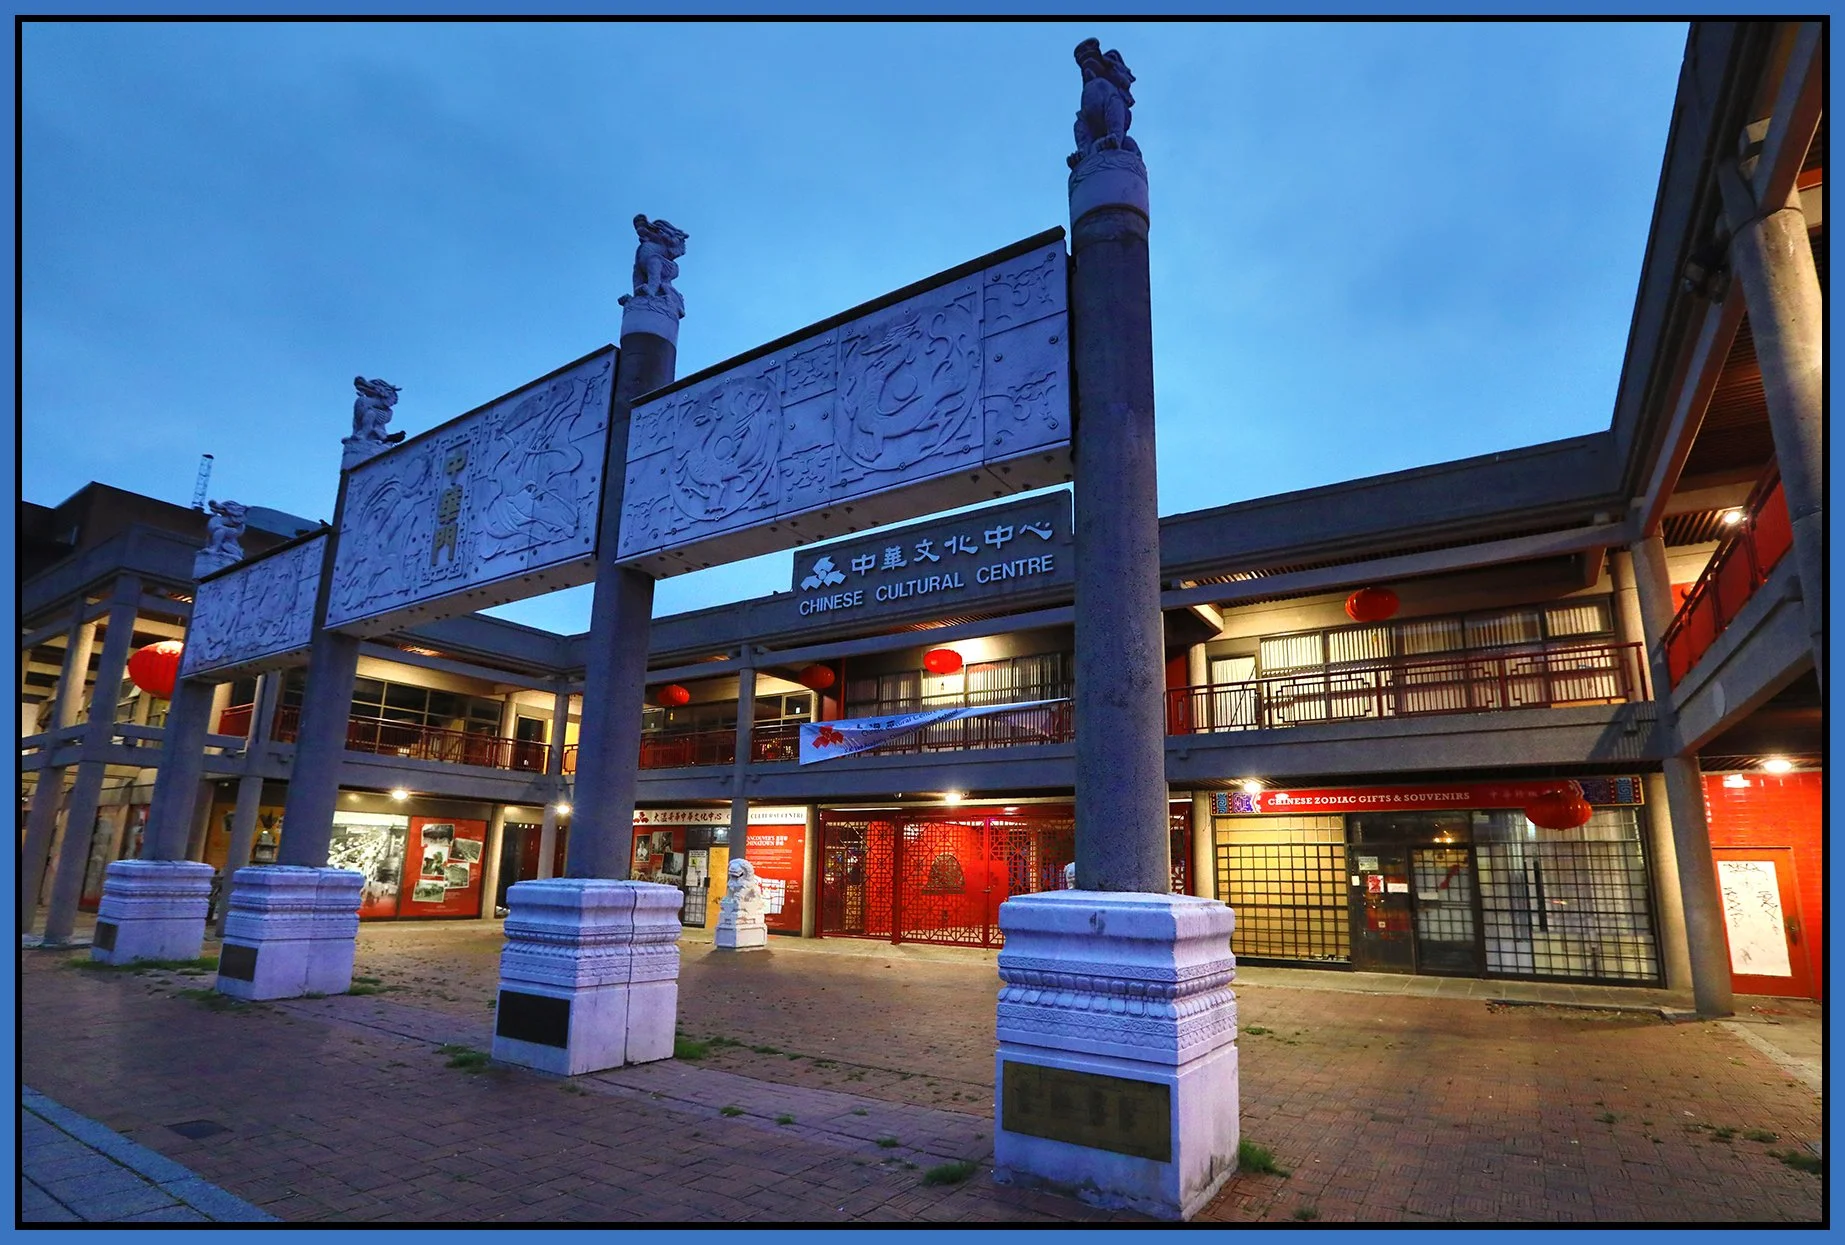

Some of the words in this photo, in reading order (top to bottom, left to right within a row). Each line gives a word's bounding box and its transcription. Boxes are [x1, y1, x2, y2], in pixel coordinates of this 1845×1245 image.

[851, 521, 1054, 577] 中華文化中心
[799, 590, 863, 616] CHINESE
[876, 571, 965, 601] CULTURAL
[976, 554, 1054, 584] CENTRE
[1268, 797, 1312, 806] CHINESE
[1314, 795, 1356, 805] ZODIAC
[1358, 794, 1391, 804] GIFTS
[1393, 793, 1402, 803] &
[1404, 792, 1470, 802] SOUVENIRS
